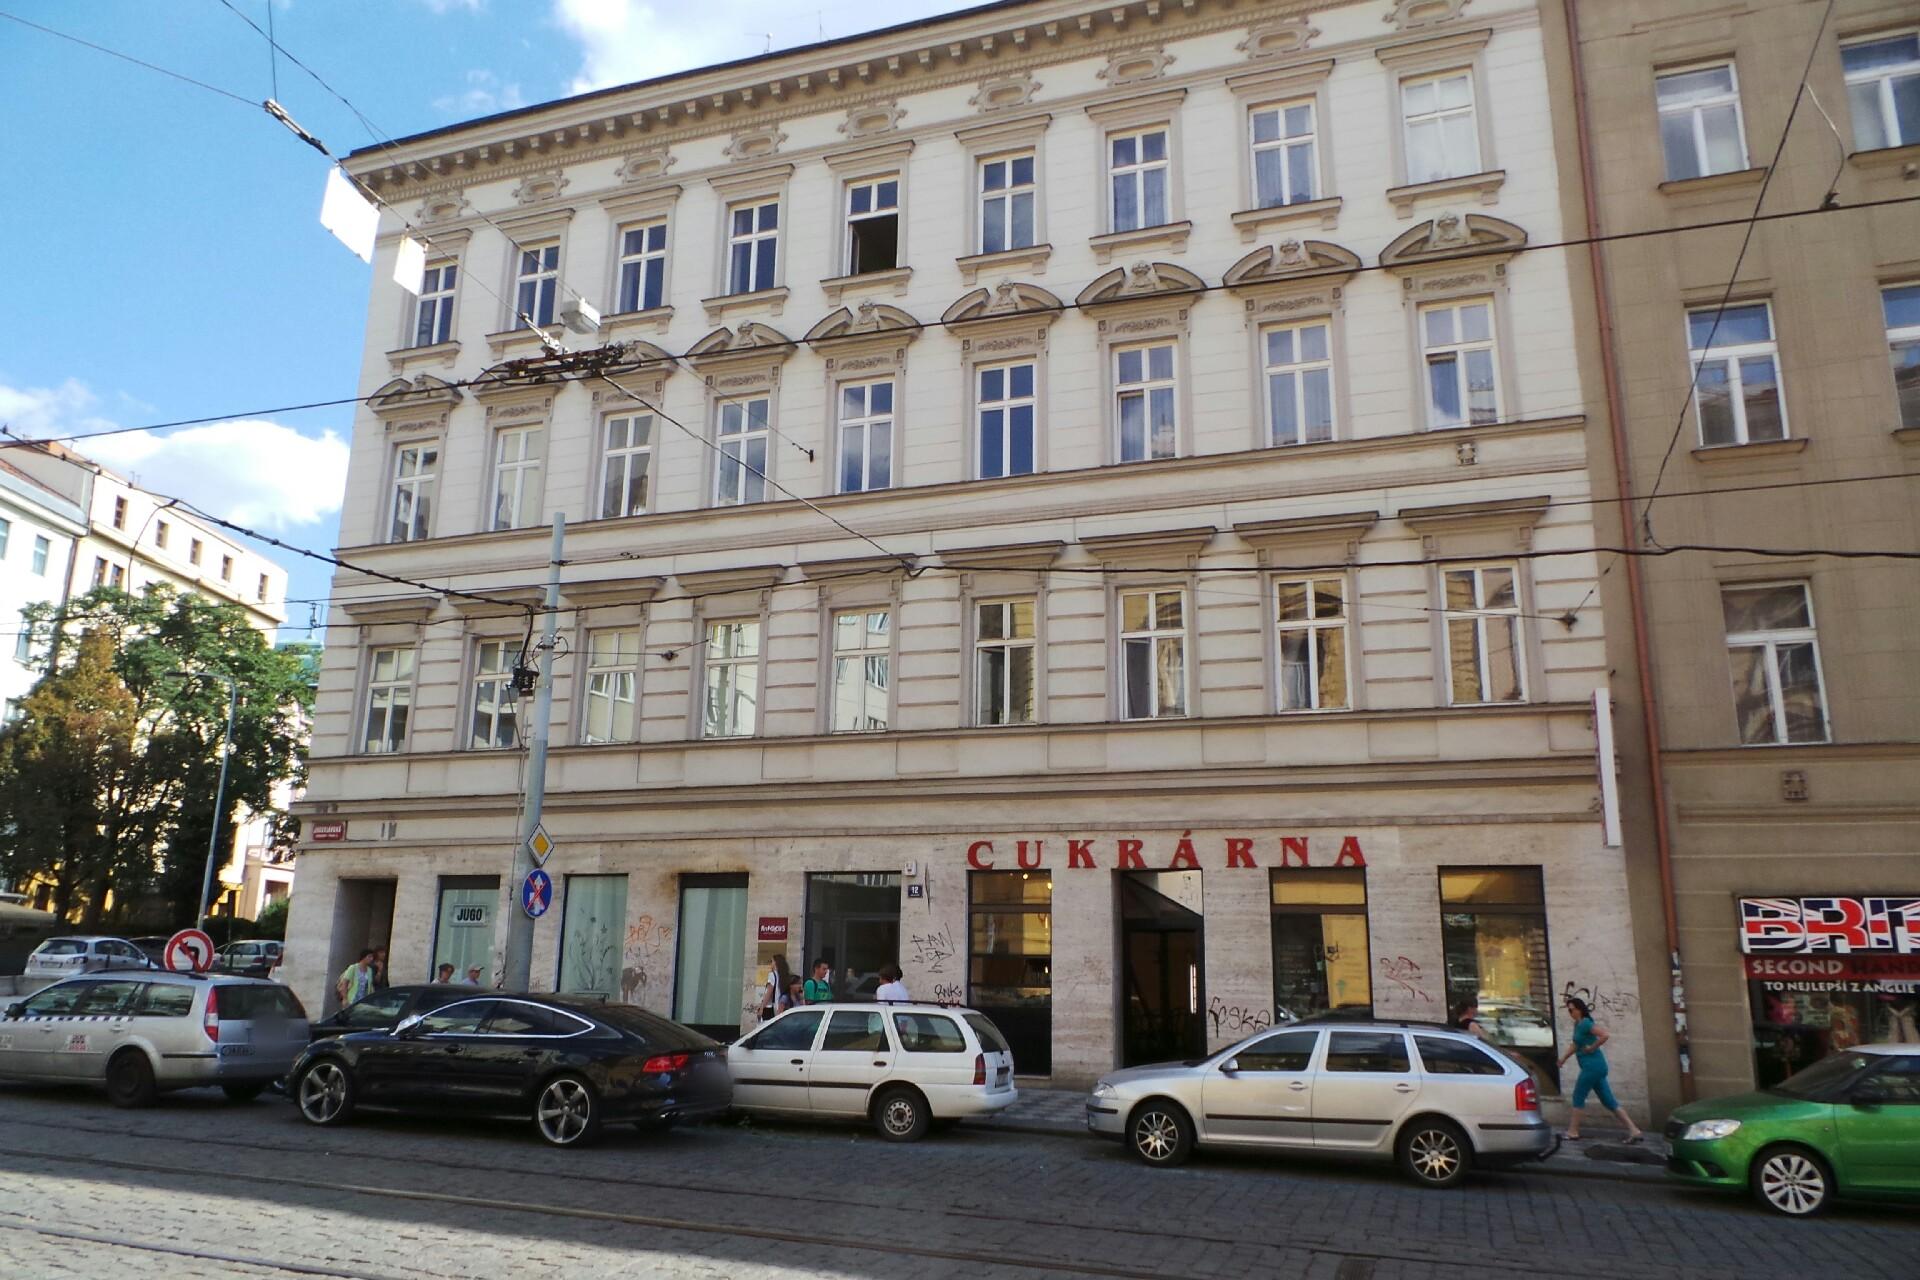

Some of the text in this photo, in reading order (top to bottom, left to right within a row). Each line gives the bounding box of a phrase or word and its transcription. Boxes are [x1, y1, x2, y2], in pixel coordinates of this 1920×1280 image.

[967, 830, 1367, 870] CUKRÁRNA
[911, 886, 919, 894] 12
[457, 908, 482, 921] JUGO
[1753, 959, 1844, 975] SECOND
[1764, 980, 1916, 994] TO NEJLEPŠÍ Z ANGLIE
